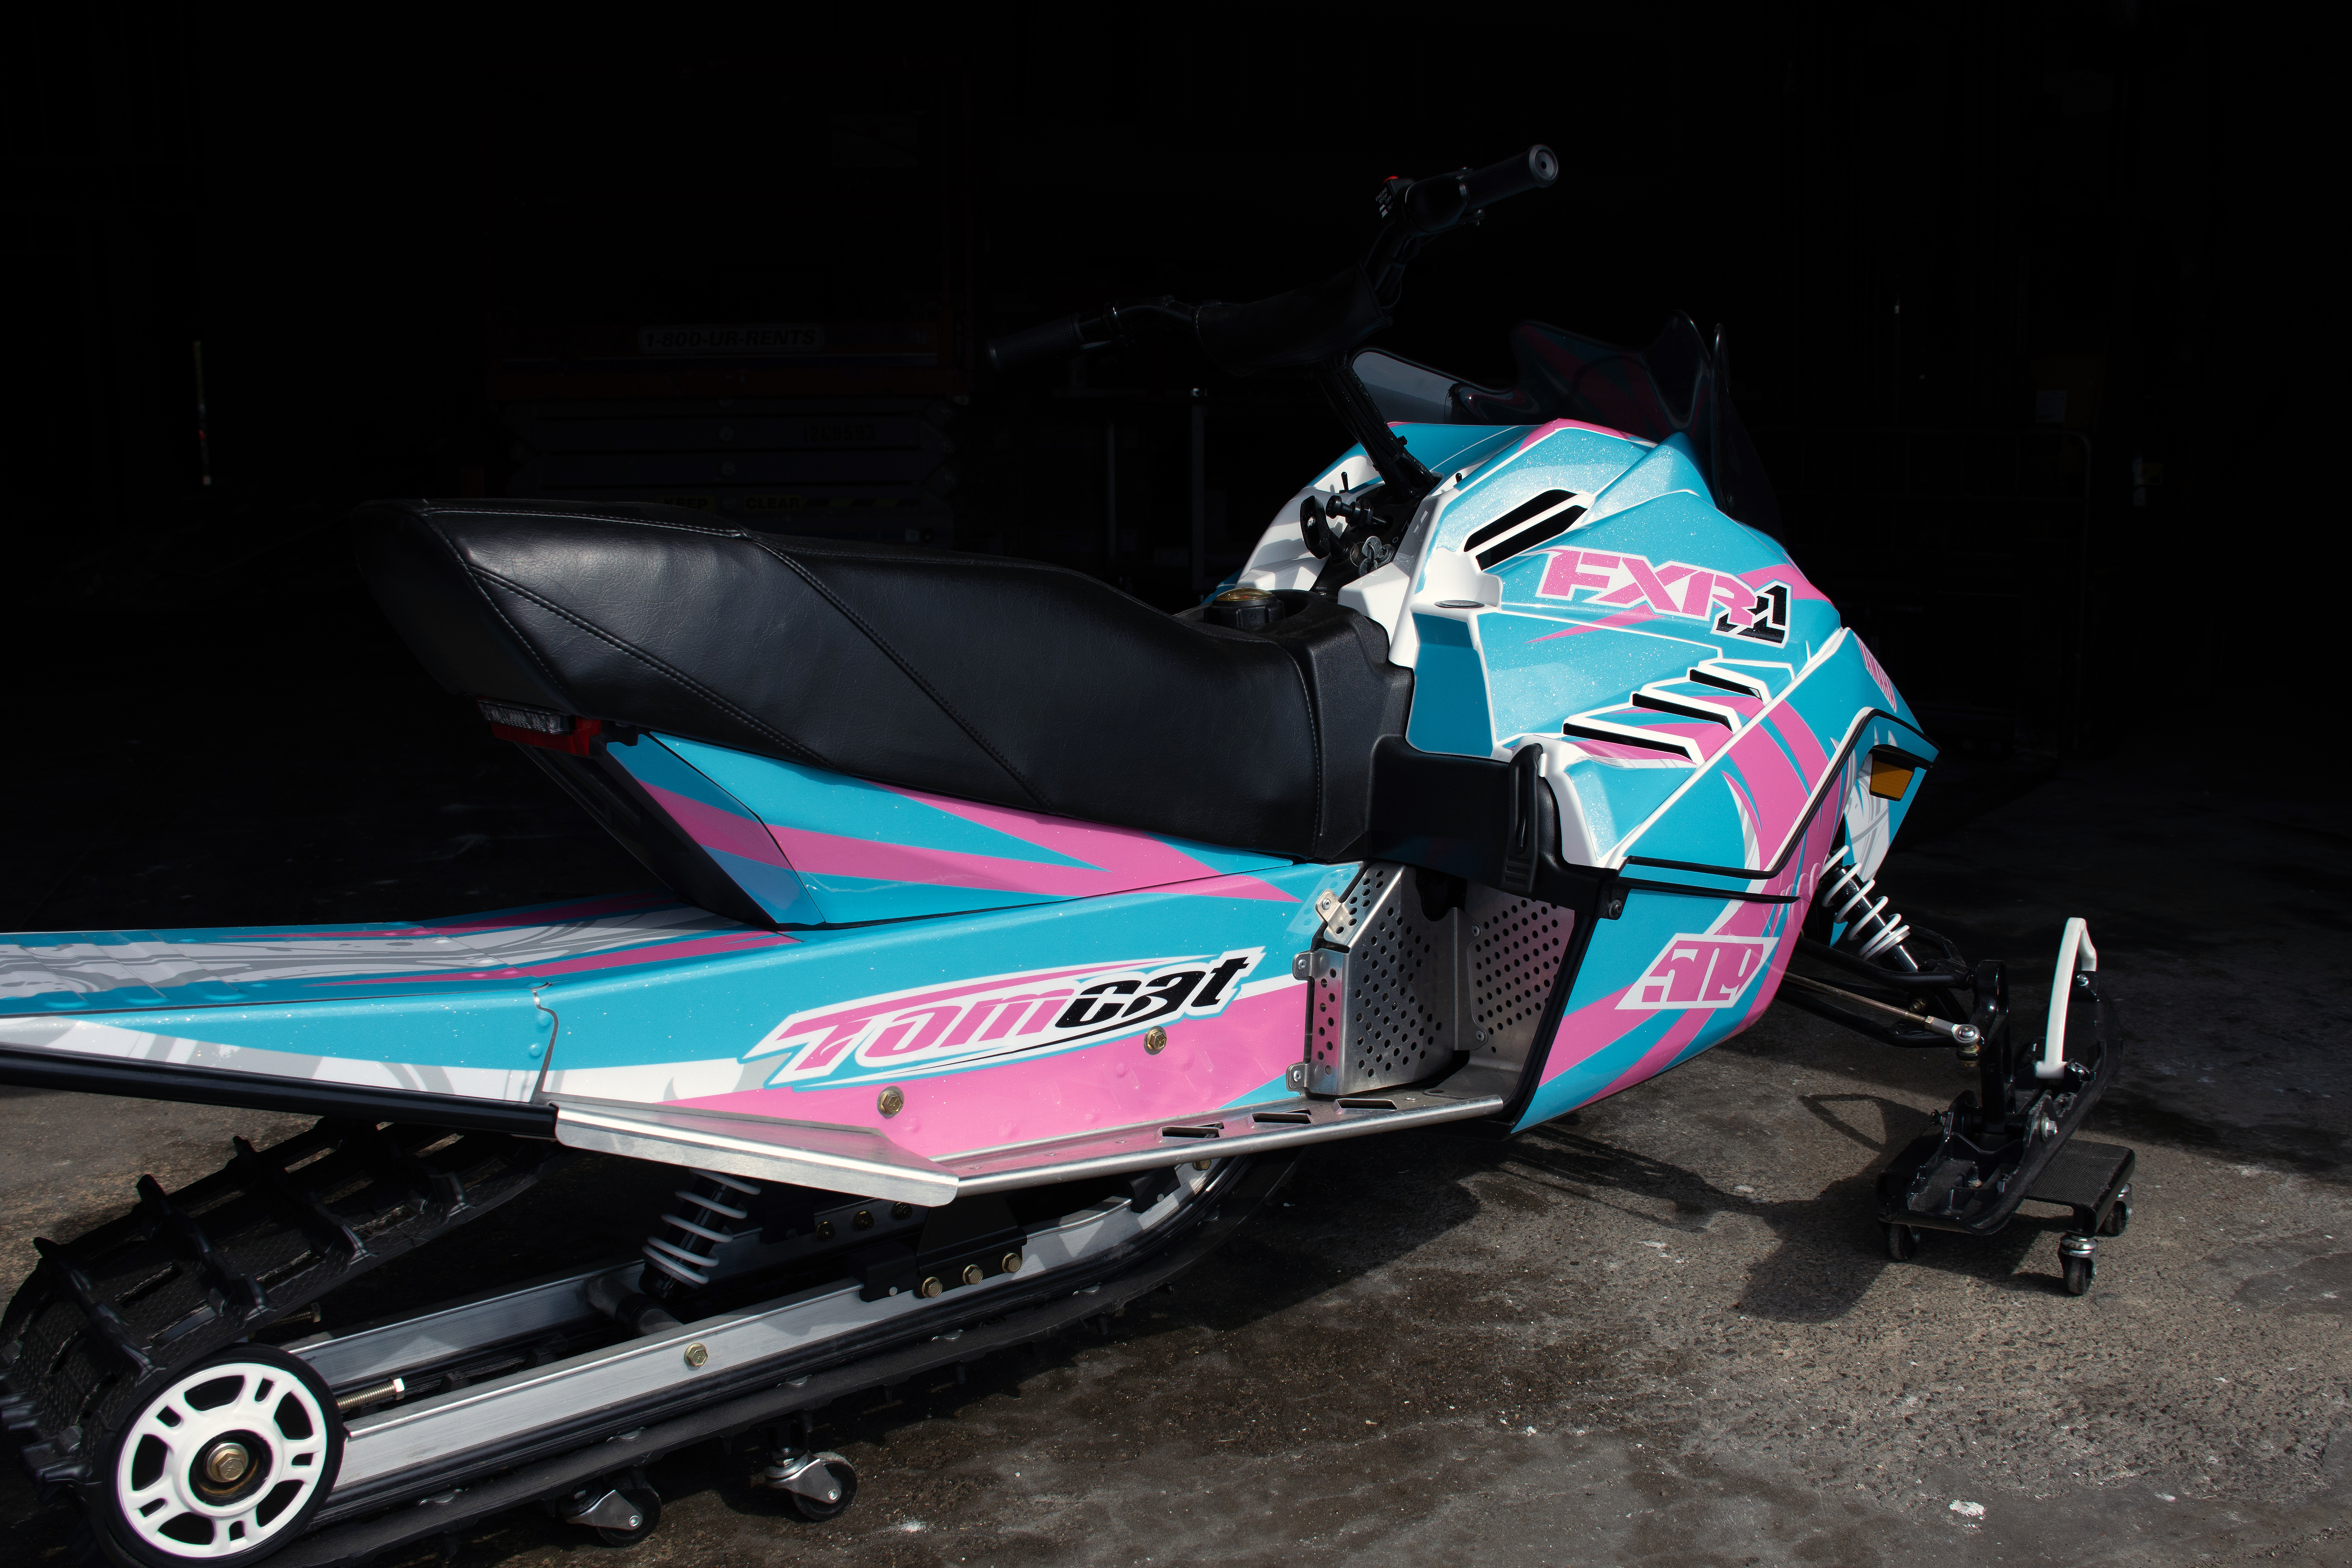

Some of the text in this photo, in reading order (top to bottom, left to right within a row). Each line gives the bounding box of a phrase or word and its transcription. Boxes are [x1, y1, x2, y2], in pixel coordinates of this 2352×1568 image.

[645, 329, 816, 347] 1-800-UR-RENTS
[745, 498, 800, 509] CLEAR
[1540, 549, 1757, 627] FXR
[1639, 939, 1765, 1004] 509
